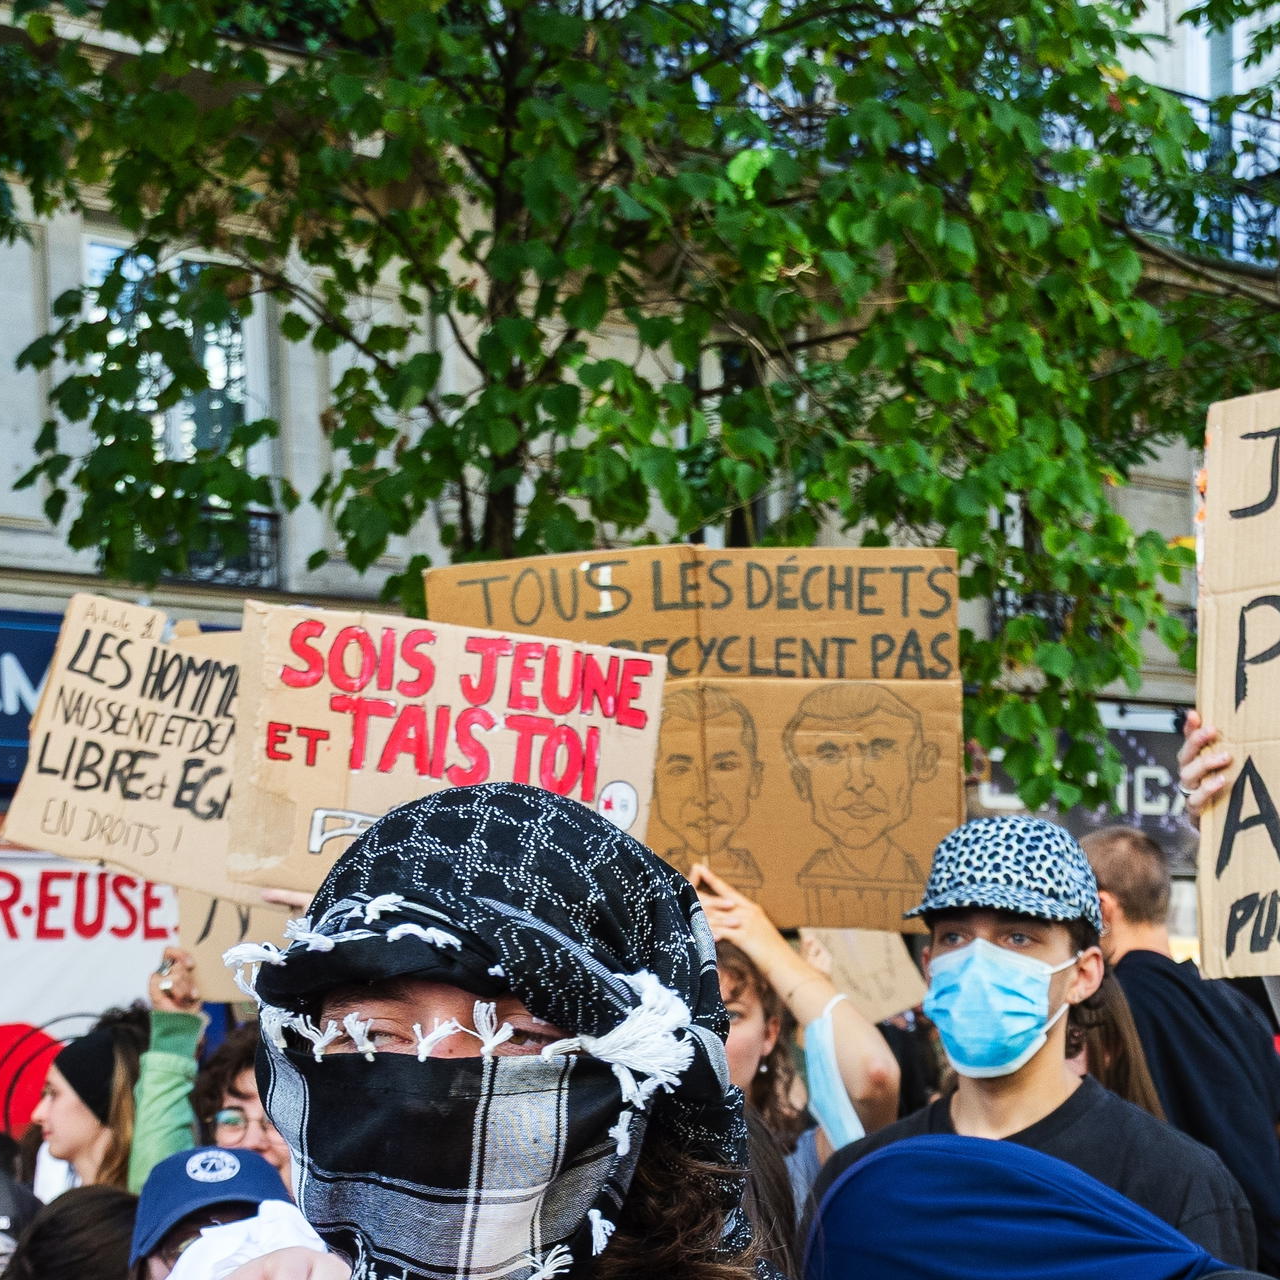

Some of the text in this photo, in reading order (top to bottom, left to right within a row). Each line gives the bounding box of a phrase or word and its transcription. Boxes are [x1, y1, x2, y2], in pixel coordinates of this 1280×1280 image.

[457, 554, 956, 628] TOUS LES DÉCHETS
[66, 627, 134, 691] LES
[279, 617, 654, 732] SOIS JEUNE
[608, 627, 956, 681] CYCLENT PAS
[36, 731, 160, 801] LIBRE
[265, 693, 601, 803] ET TAIS TOI
[39, 797, 78, 838] EN
[80, 807, 161, 857] DROITS
